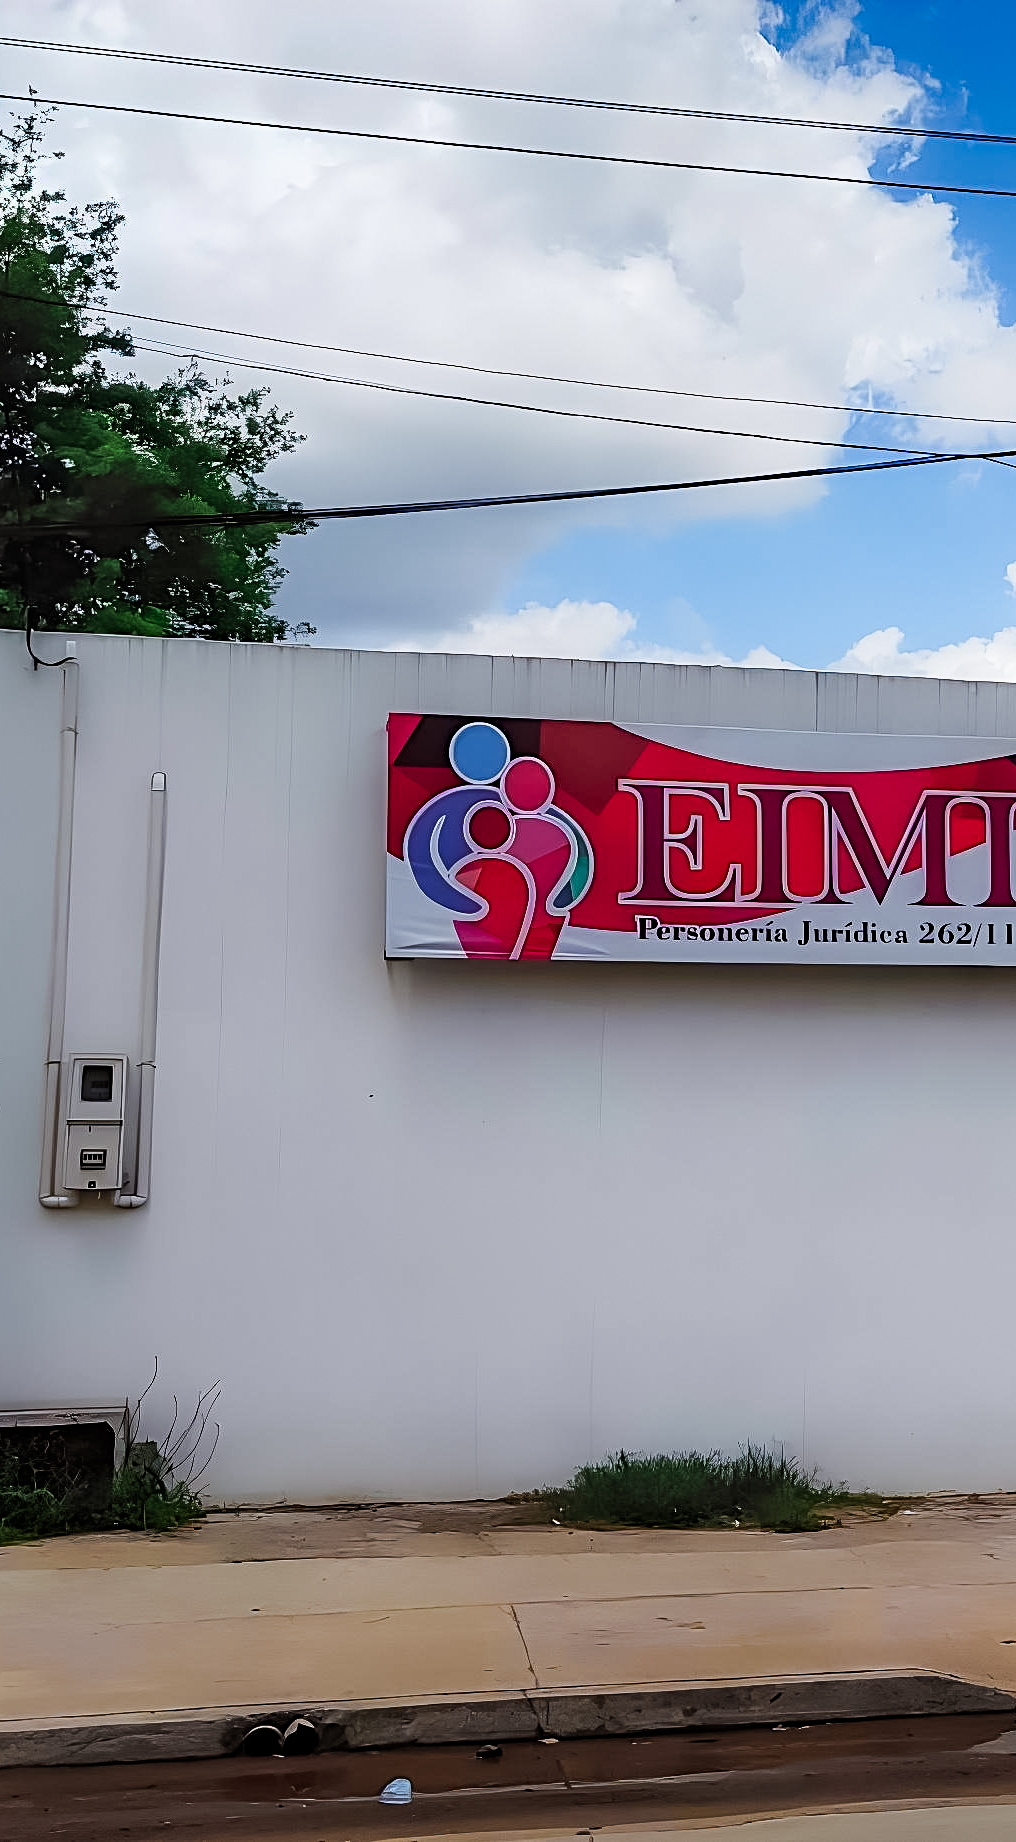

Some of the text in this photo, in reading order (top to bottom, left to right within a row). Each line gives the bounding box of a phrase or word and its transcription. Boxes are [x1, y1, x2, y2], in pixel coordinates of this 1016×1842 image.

[637, 917, 1014, 947] Personería Jurídica 262/11
